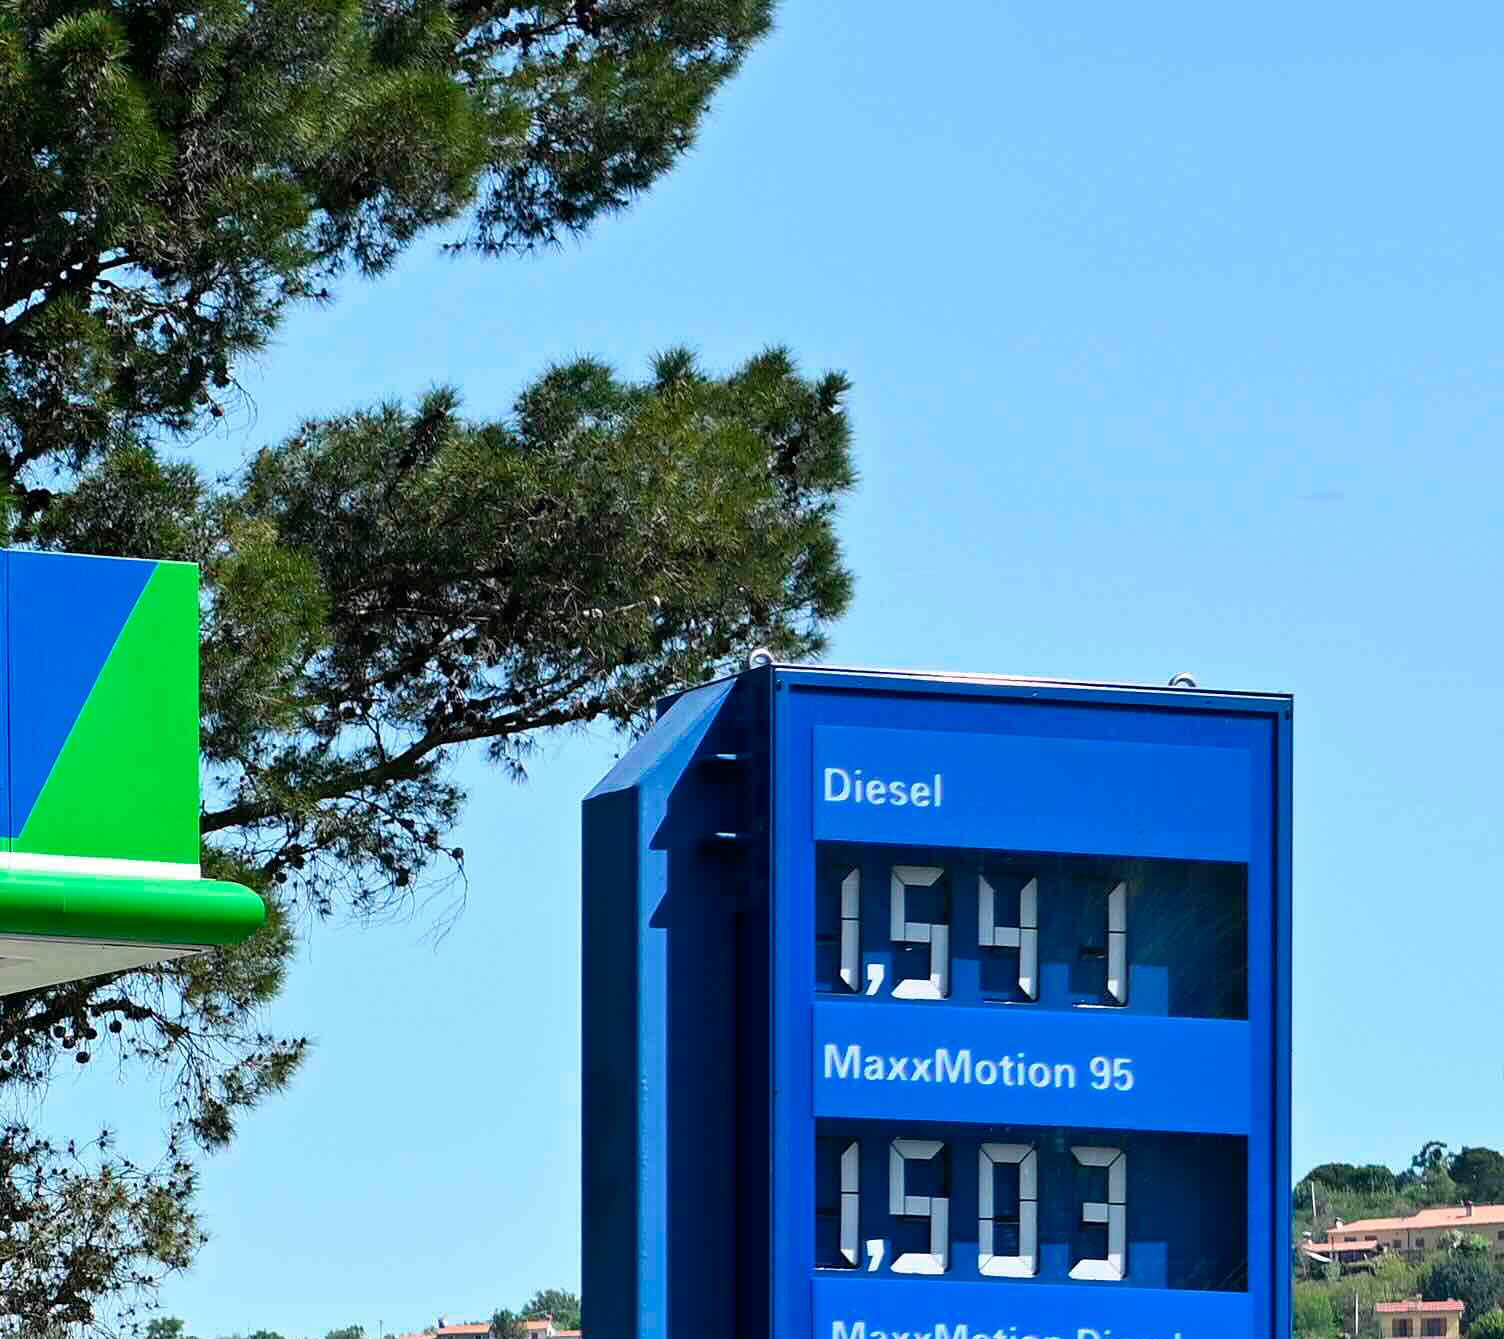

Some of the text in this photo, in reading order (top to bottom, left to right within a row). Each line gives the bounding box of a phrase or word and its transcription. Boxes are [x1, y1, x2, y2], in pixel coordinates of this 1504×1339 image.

[824, 767, 942, 807] Diesel
[839, 864, 1128, 1004] 1,541
[823, 1043, 1134, 1092] MaxxMotion 95
[839, 1139, 1127, 1281] 1,503
